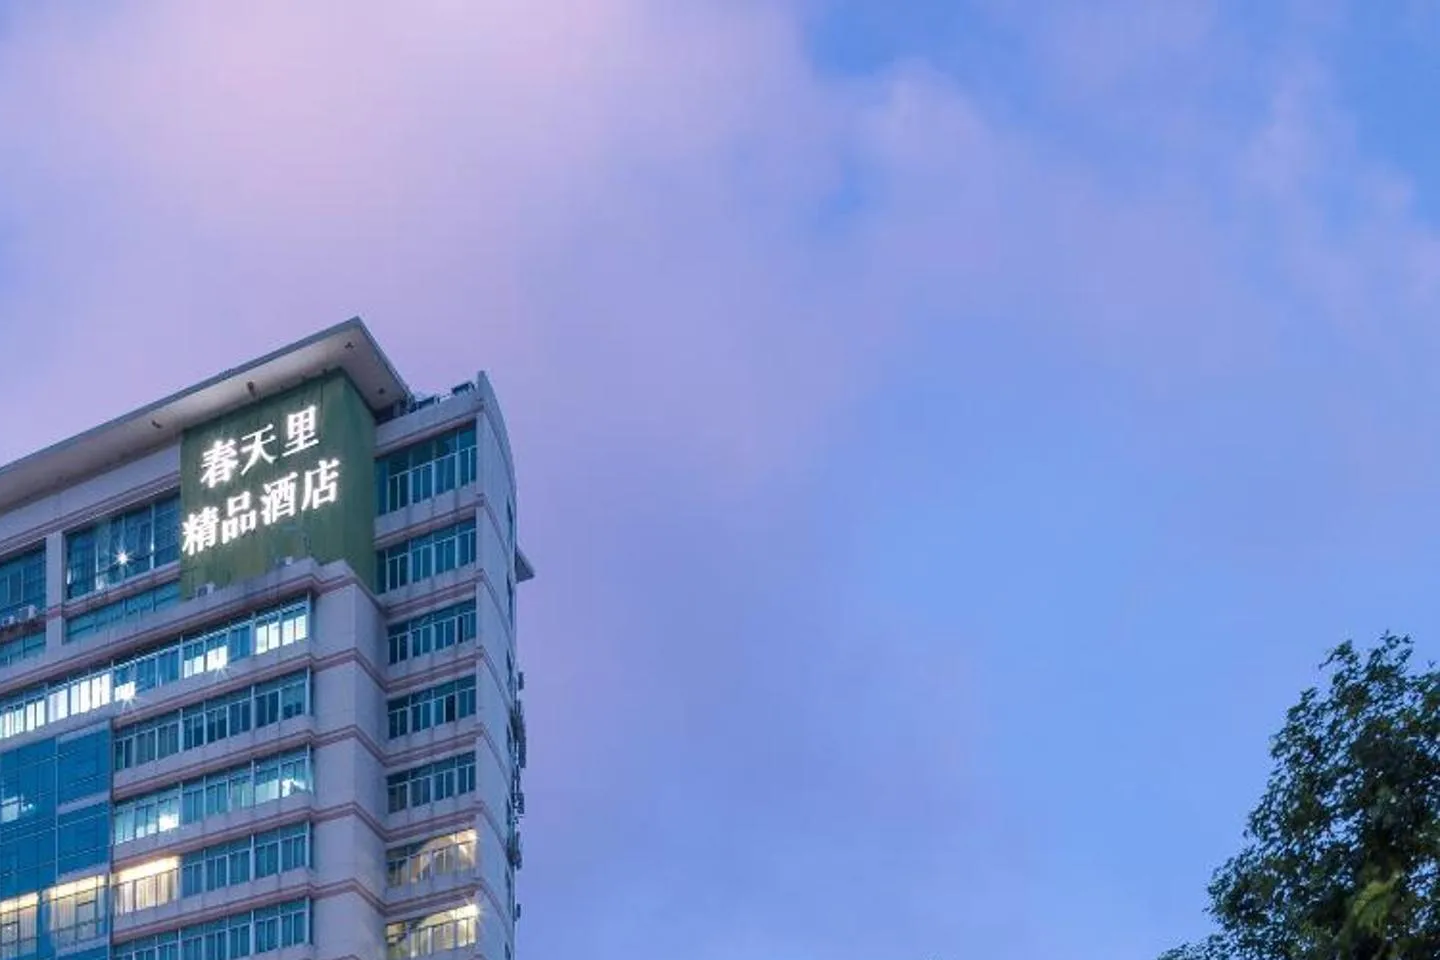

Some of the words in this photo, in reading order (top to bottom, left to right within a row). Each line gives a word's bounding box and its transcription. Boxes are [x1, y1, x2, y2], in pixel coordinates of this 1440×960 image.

[200, 406, 319, 488] 春天里
[181, 458, 340, 556] 精品酒店
